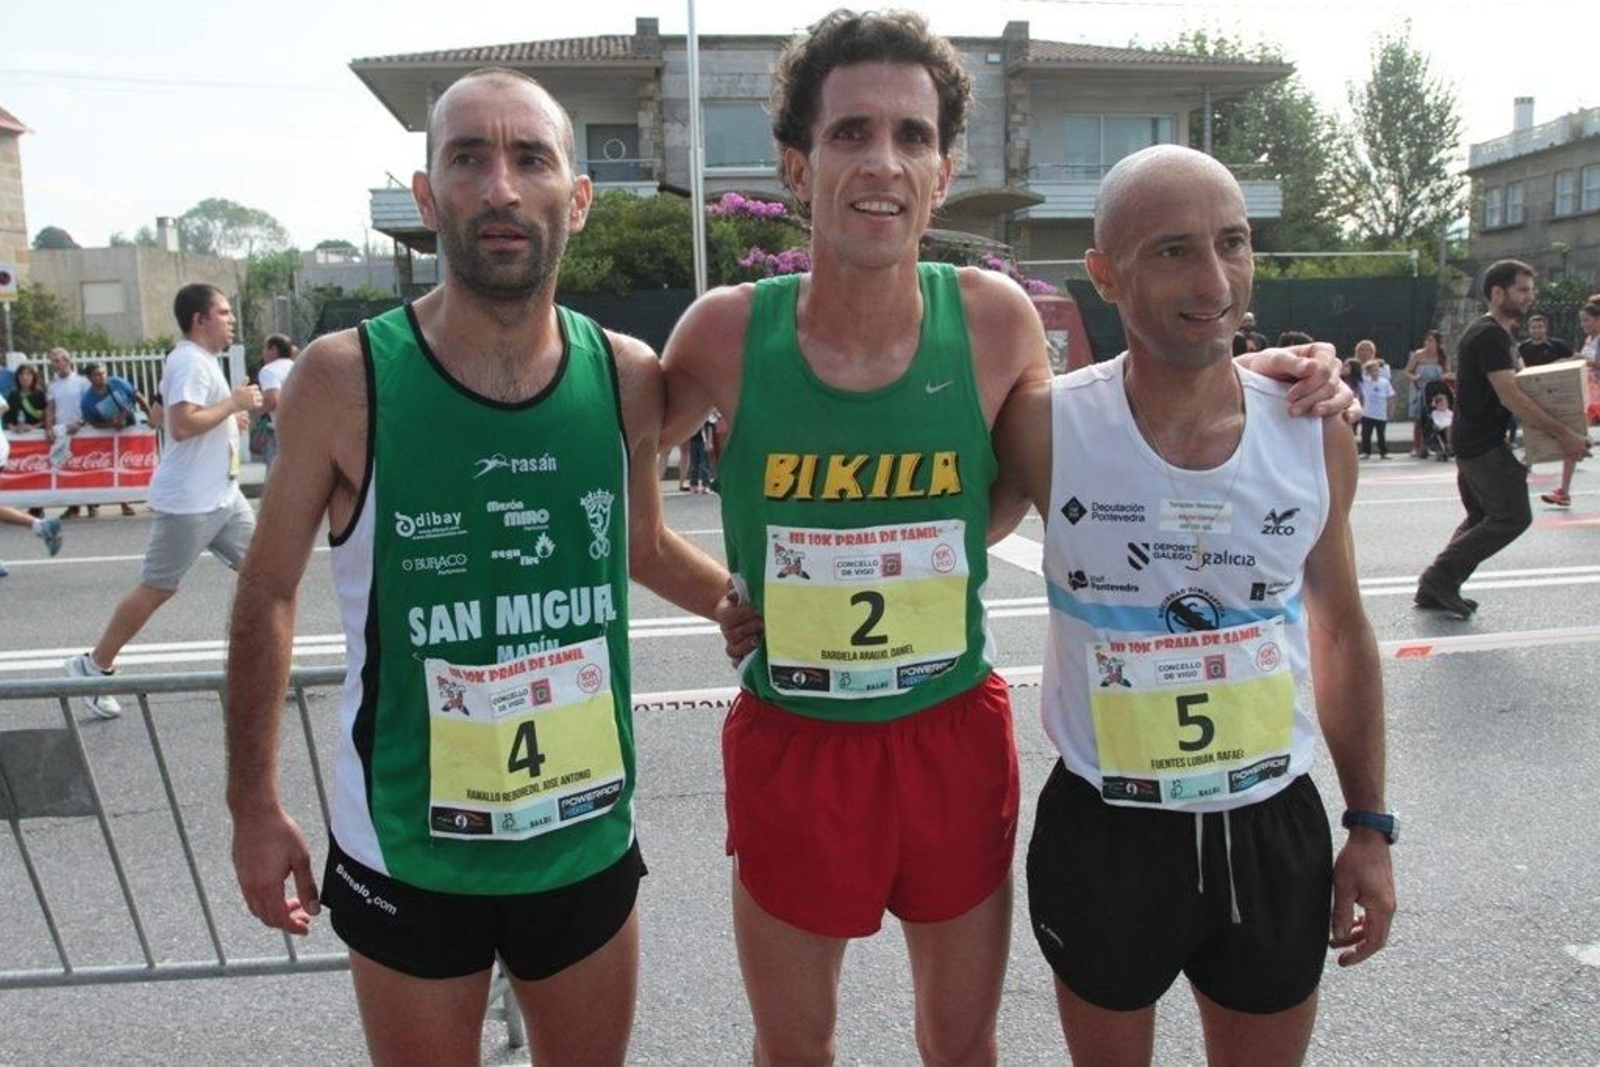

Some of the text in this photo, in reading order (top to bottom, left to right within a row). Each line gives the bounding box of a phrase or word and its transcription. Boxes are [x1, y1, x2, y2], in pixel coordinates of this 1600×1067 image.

[511, 453, 557, 474] rasán
[763, 451, 962, 501] BIKILA
[1091, 501, 1146, 513] Deputación
[1091, 511, 1146, 523] Pontevedra
[789, 526, 939, 547] III 10K PRAIA DE SAMIL
[1261, 524, 1295, 536] ZICO
[836, 560, 879, 569] CONCELLO
[1153, 551, 1193, 561] GALEGO
[1188, 549, 1257, 570] galicia
[841, 568, 875, 576] DE VIGO
[1091, 582, 1140, 593] Pontevedra
[408, 600, 482, 647] SAN
[850, 590, 888, 646] 2
[1128, 641, 1151, 654] 10K
[1155, 636, 1200, 651] PRAIA
[1202, 633, 1220, 646] DE
[1223, 627, 1263, 645] SAMIL
[465, 671, 487, 684] 10K
[489, 661, 527, 682] PRAIA
[528, 656, 546, 671] DE
[548, 647, 585, 666] SAMIL
[1157, 662, 1202, 672] CONCELLO
[1164, 671, 1198, 680] DE VIGO
[493, 688, 529, 705] CONCELLO
[508, 699, 525, 709] VIGO
[1175, 692, 1215, 752] 5
[508, 720, 546, 778] 4
[1151, 757, 1186, 769] FUENTES
[466, 789, 501, 802] RAMALLO
[560, 769, 591, 785] ANTONIO
